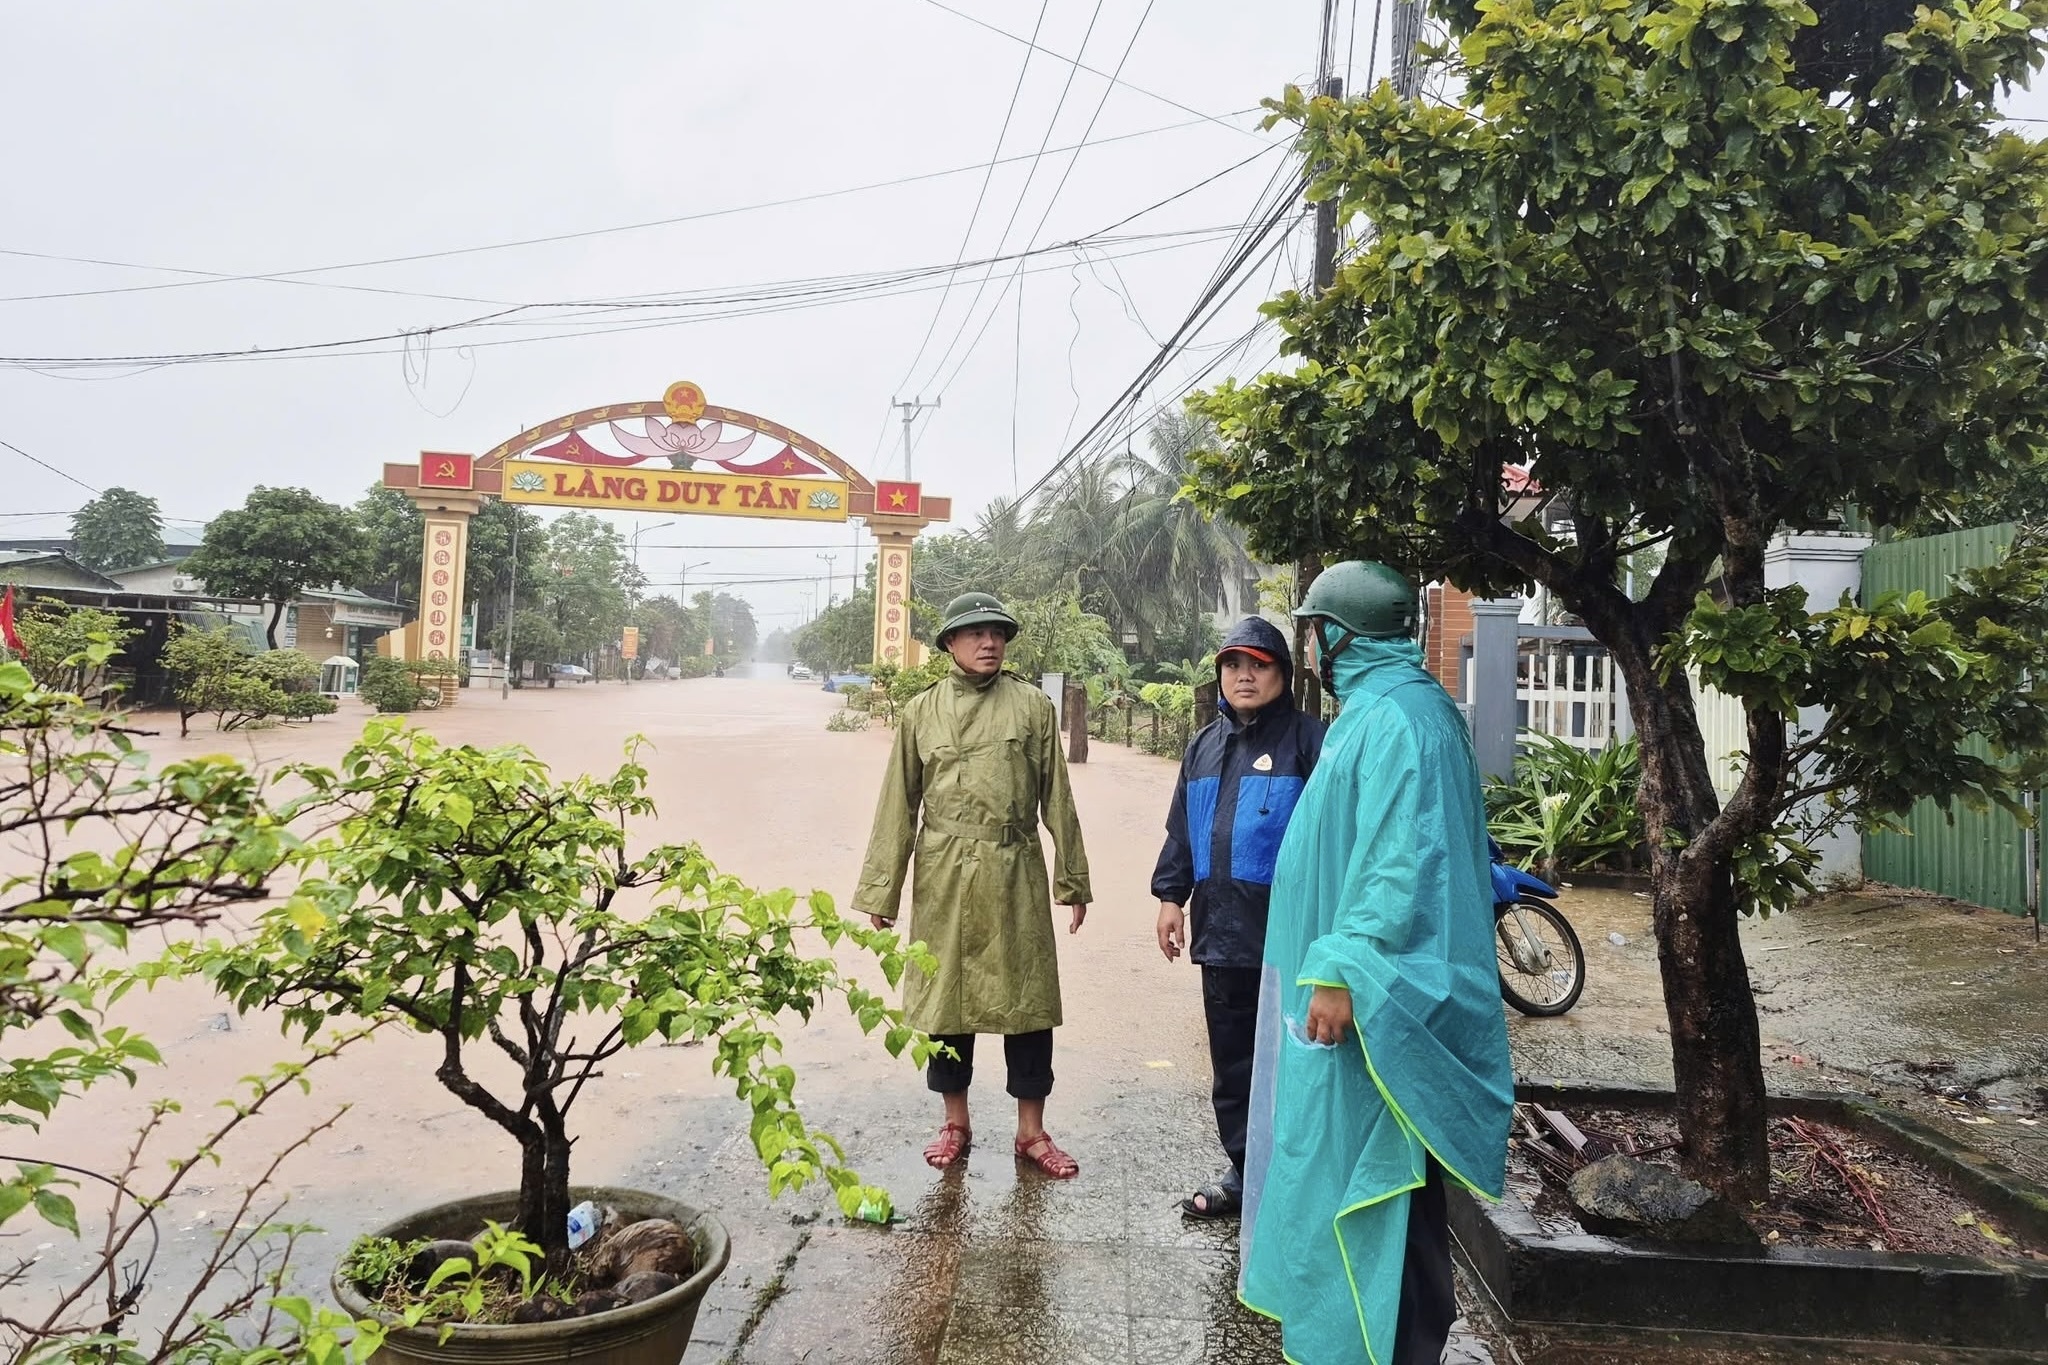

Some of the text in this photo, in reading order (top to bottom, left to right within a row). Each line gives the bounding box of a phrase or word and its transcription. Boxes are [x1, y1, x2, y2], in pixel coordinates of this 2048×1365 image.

[554, 469, 801, 510] LÀNG DUY TÂN
